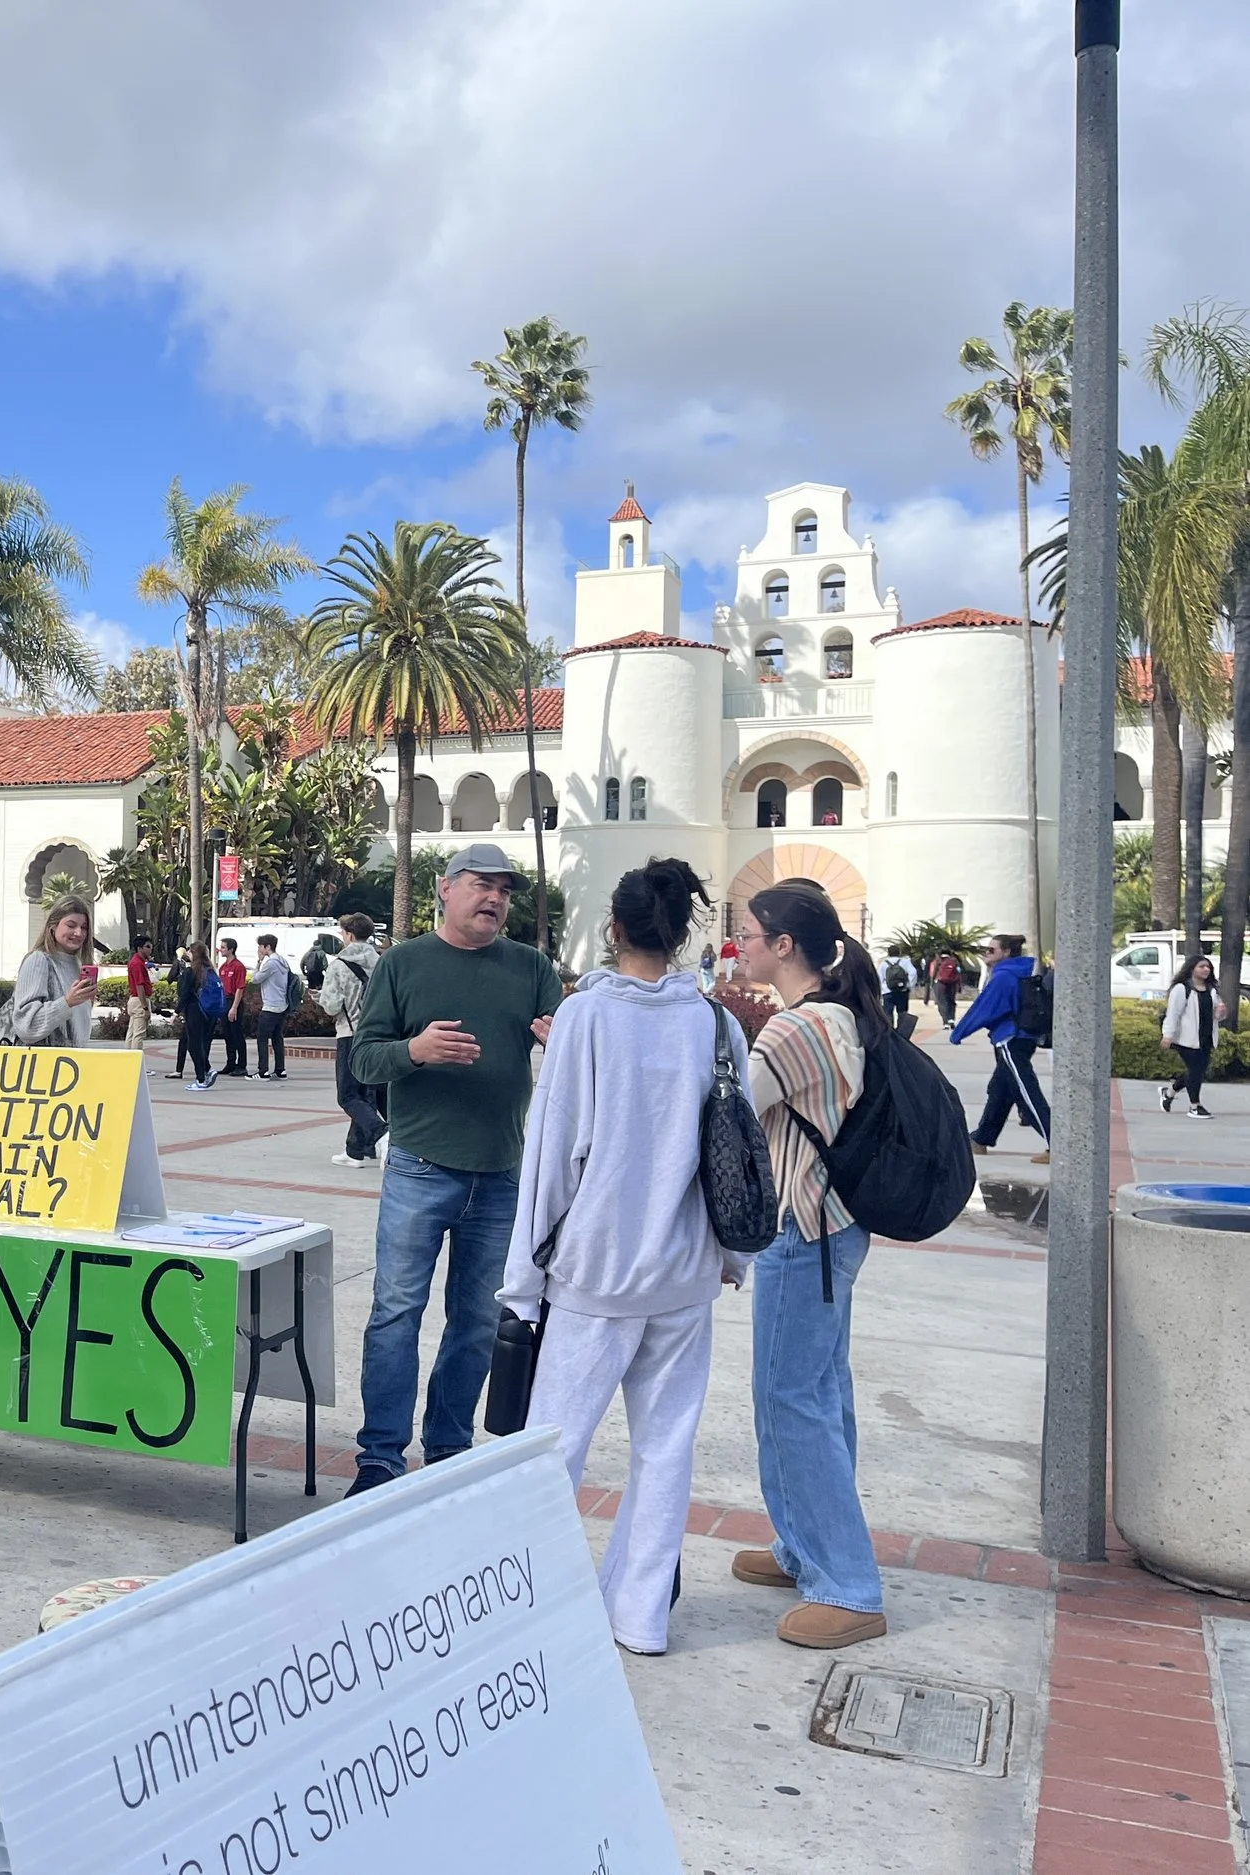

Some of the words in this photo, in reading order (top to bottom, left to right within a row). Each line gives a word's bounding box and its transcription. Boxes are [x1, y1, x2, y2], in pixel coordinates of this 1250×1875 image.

[113, 1620, 361, 1809] unintended
[365, 1547, 535, 1690] pregnancy
[220, 1791, 300, 1875] not
[304, 1719, 429, 1818] simple
[436, 1697, 469, 1758] or
[478, 1650, 549, 1732] easy
